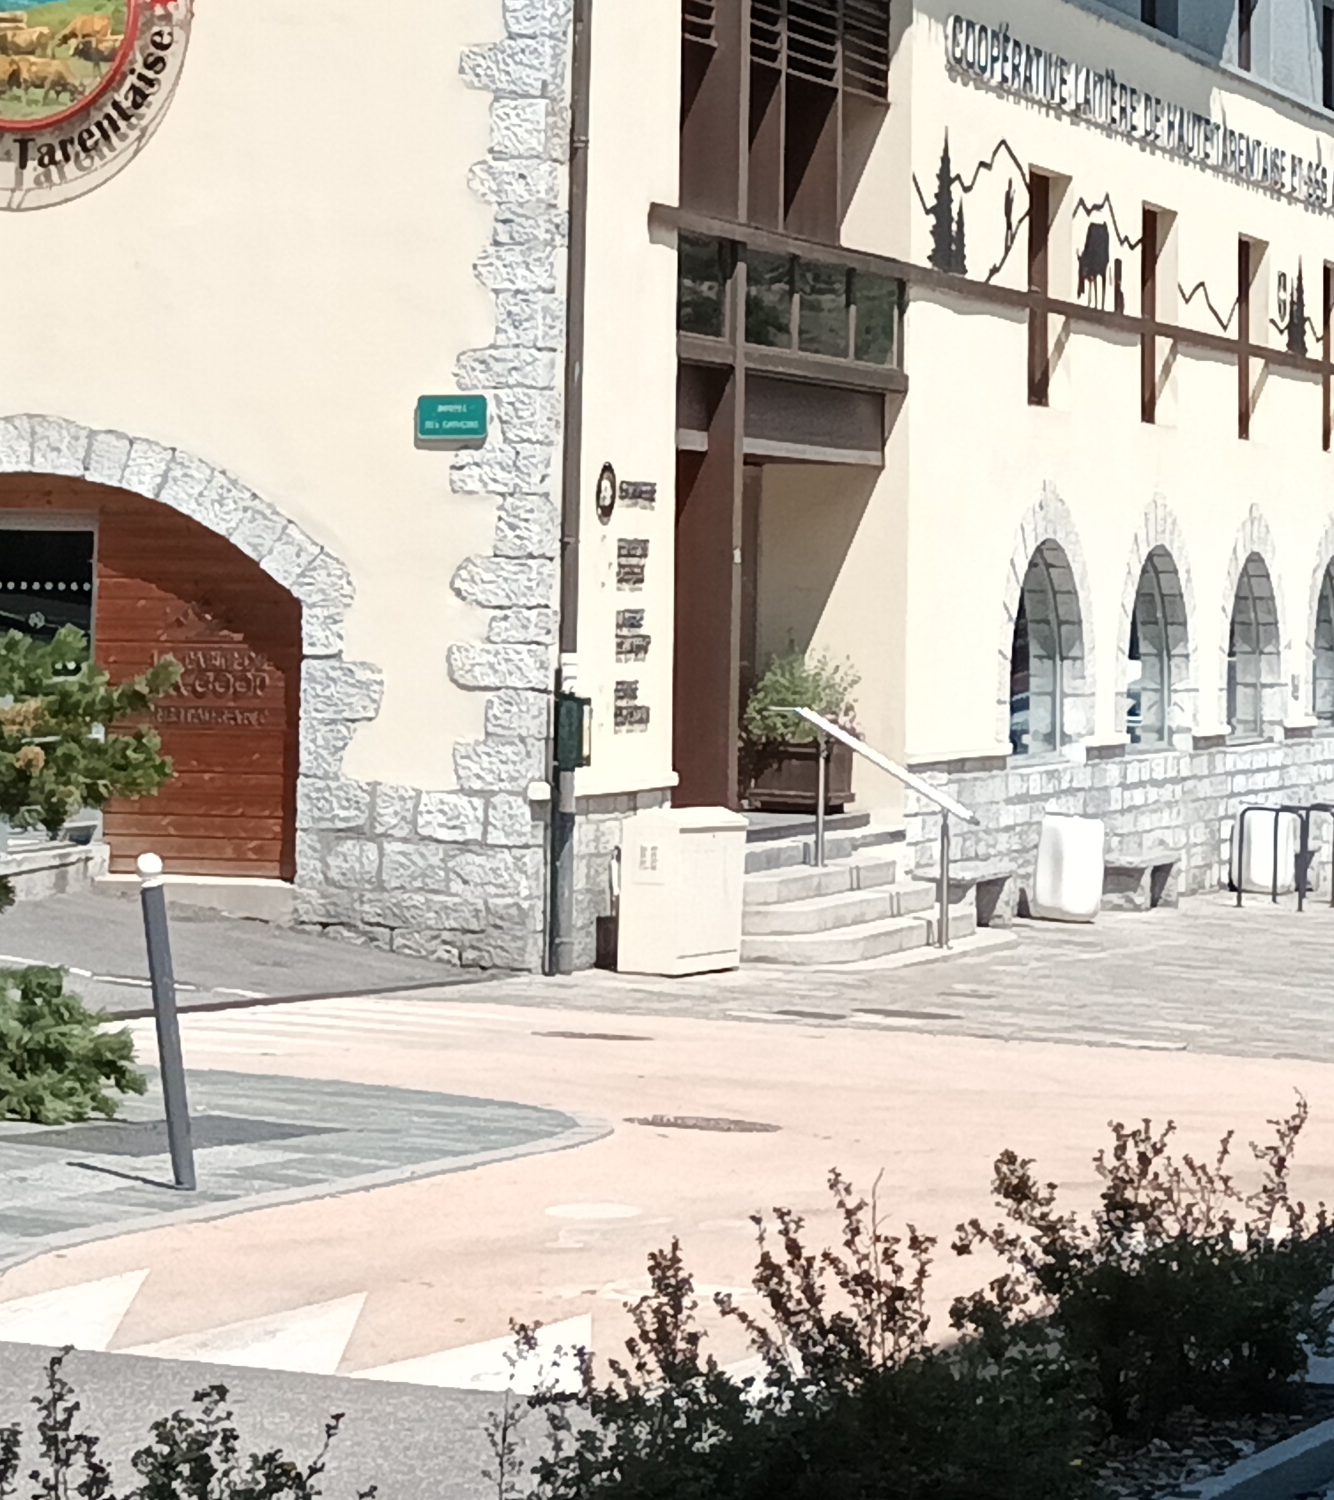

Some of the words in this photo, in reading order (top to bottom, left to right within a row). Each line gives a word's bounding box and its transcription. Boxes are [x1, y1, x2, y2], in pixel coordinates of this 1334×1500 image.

[12, 26, 175, 171] Tarentaise
[1140, 92, 1162, 141] DE
[1164, 101, 1211, 161] HAUTE
